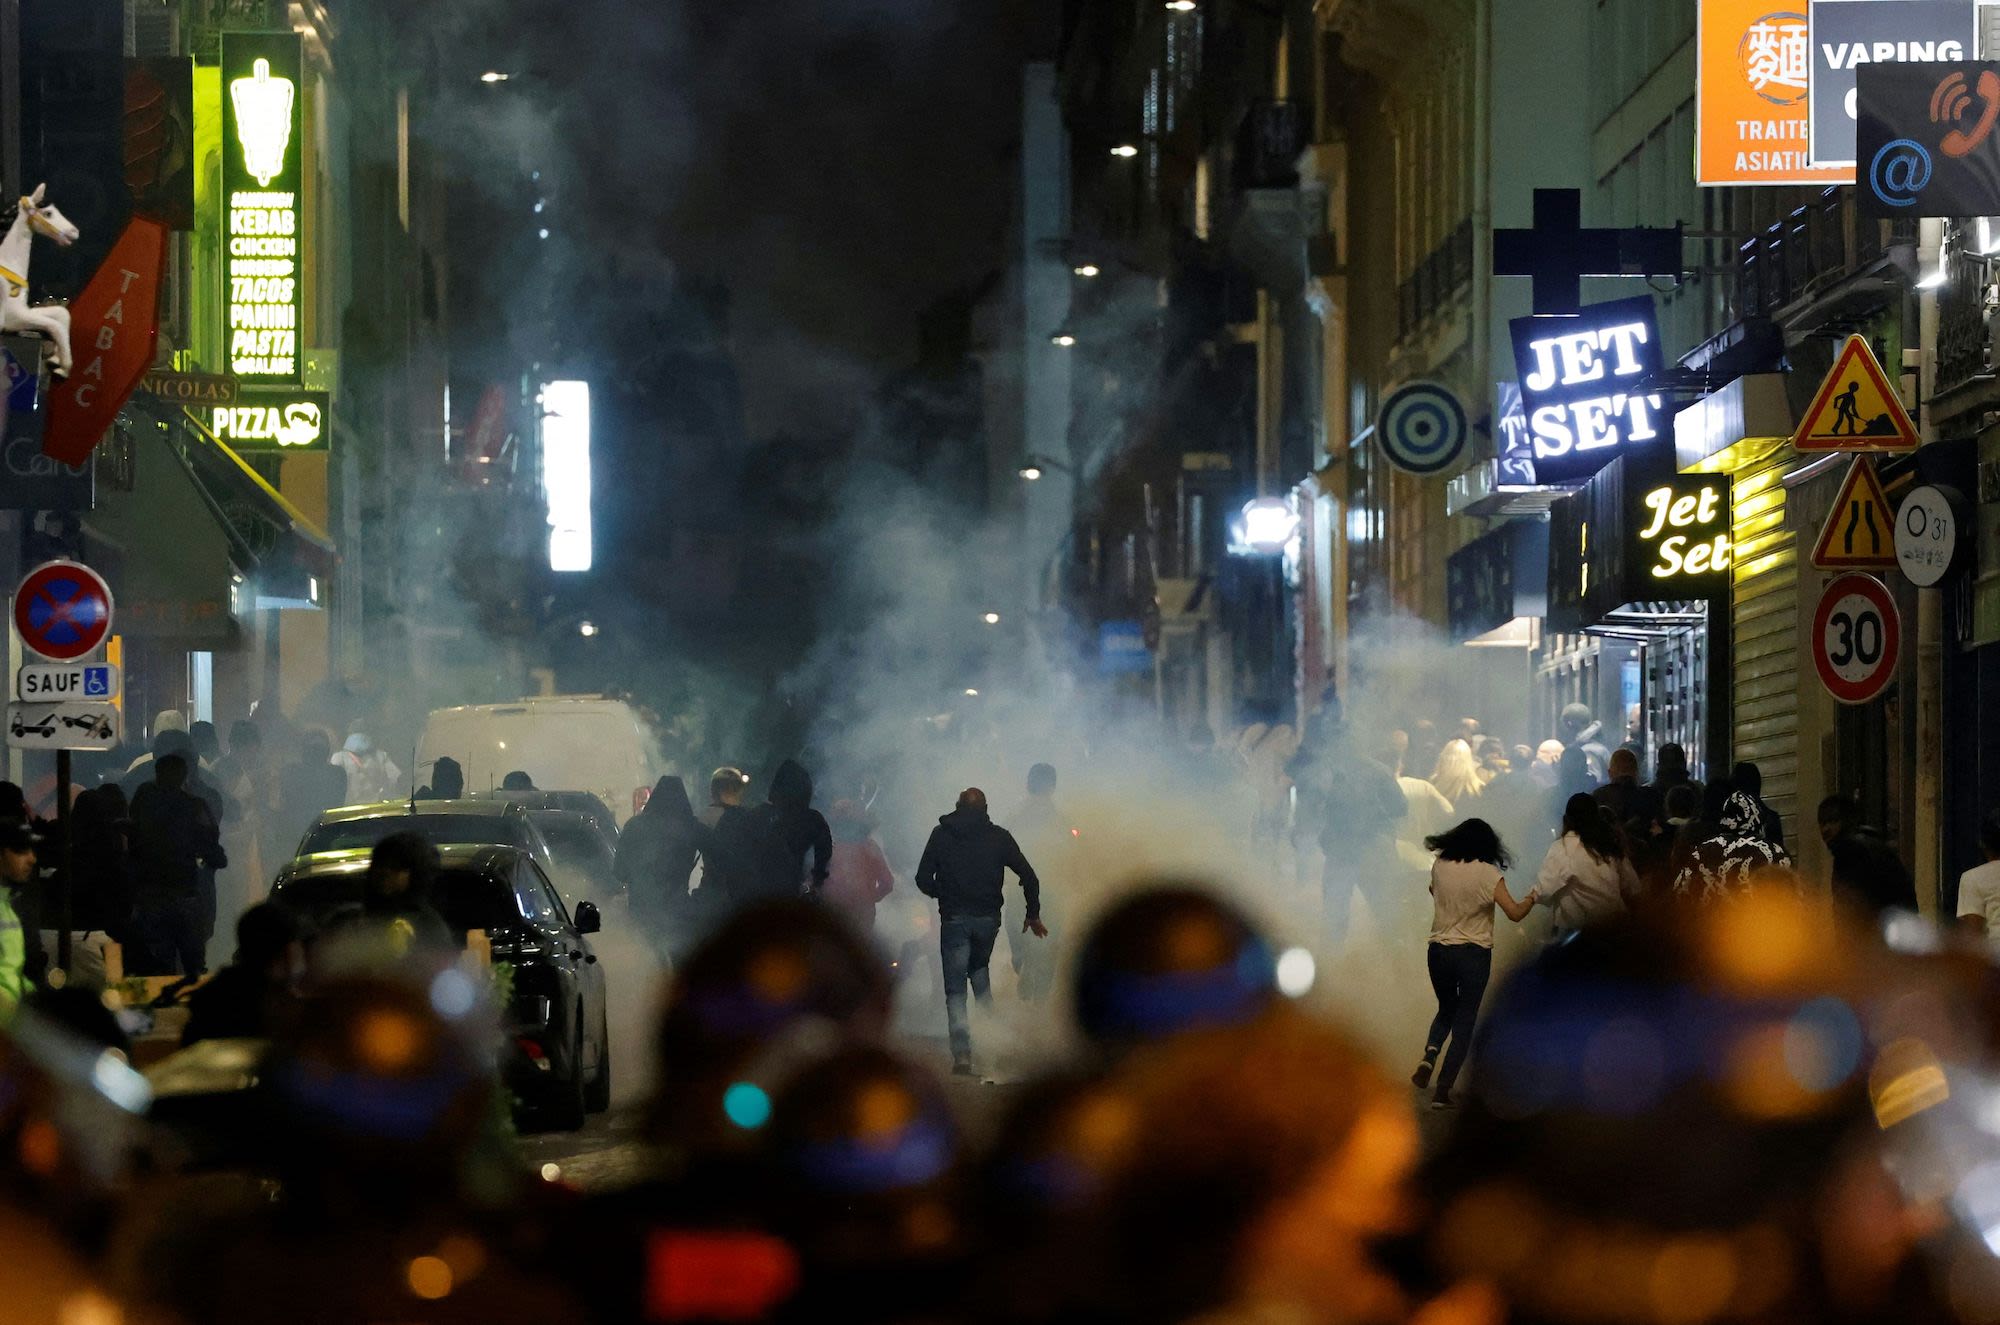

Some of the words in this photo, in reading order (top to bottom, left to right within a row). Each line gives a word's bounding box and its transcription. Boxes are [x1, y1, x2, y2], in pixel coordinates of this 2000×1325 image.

[1822, 40, 1963, 69] VAPING
[1735, 151, 1841, 171] ASIATI
[230, 209, 295, 235] KEBAB
[230, 237, 296, 256] CHICKEN
[230, 277, 295, 303] TACOS
[230, 303, 295, 329] PANINI
[75, 268, 140, 408] TABAC
[231, 330, 295, 356] PASTA
[1526, 321, 1648, 391] JET
[139, 377, 230, 400] NICOLAS
[213, 407, 281, 439] PIZZA
[1530, 393, 1662, 459] SET
[1639, 486, 1719, 539] Jet
[1651, 534, 1732, 578] Set
[1830, 611, 1882, 666] 30
[26, 673, 80, 693] SAUF
